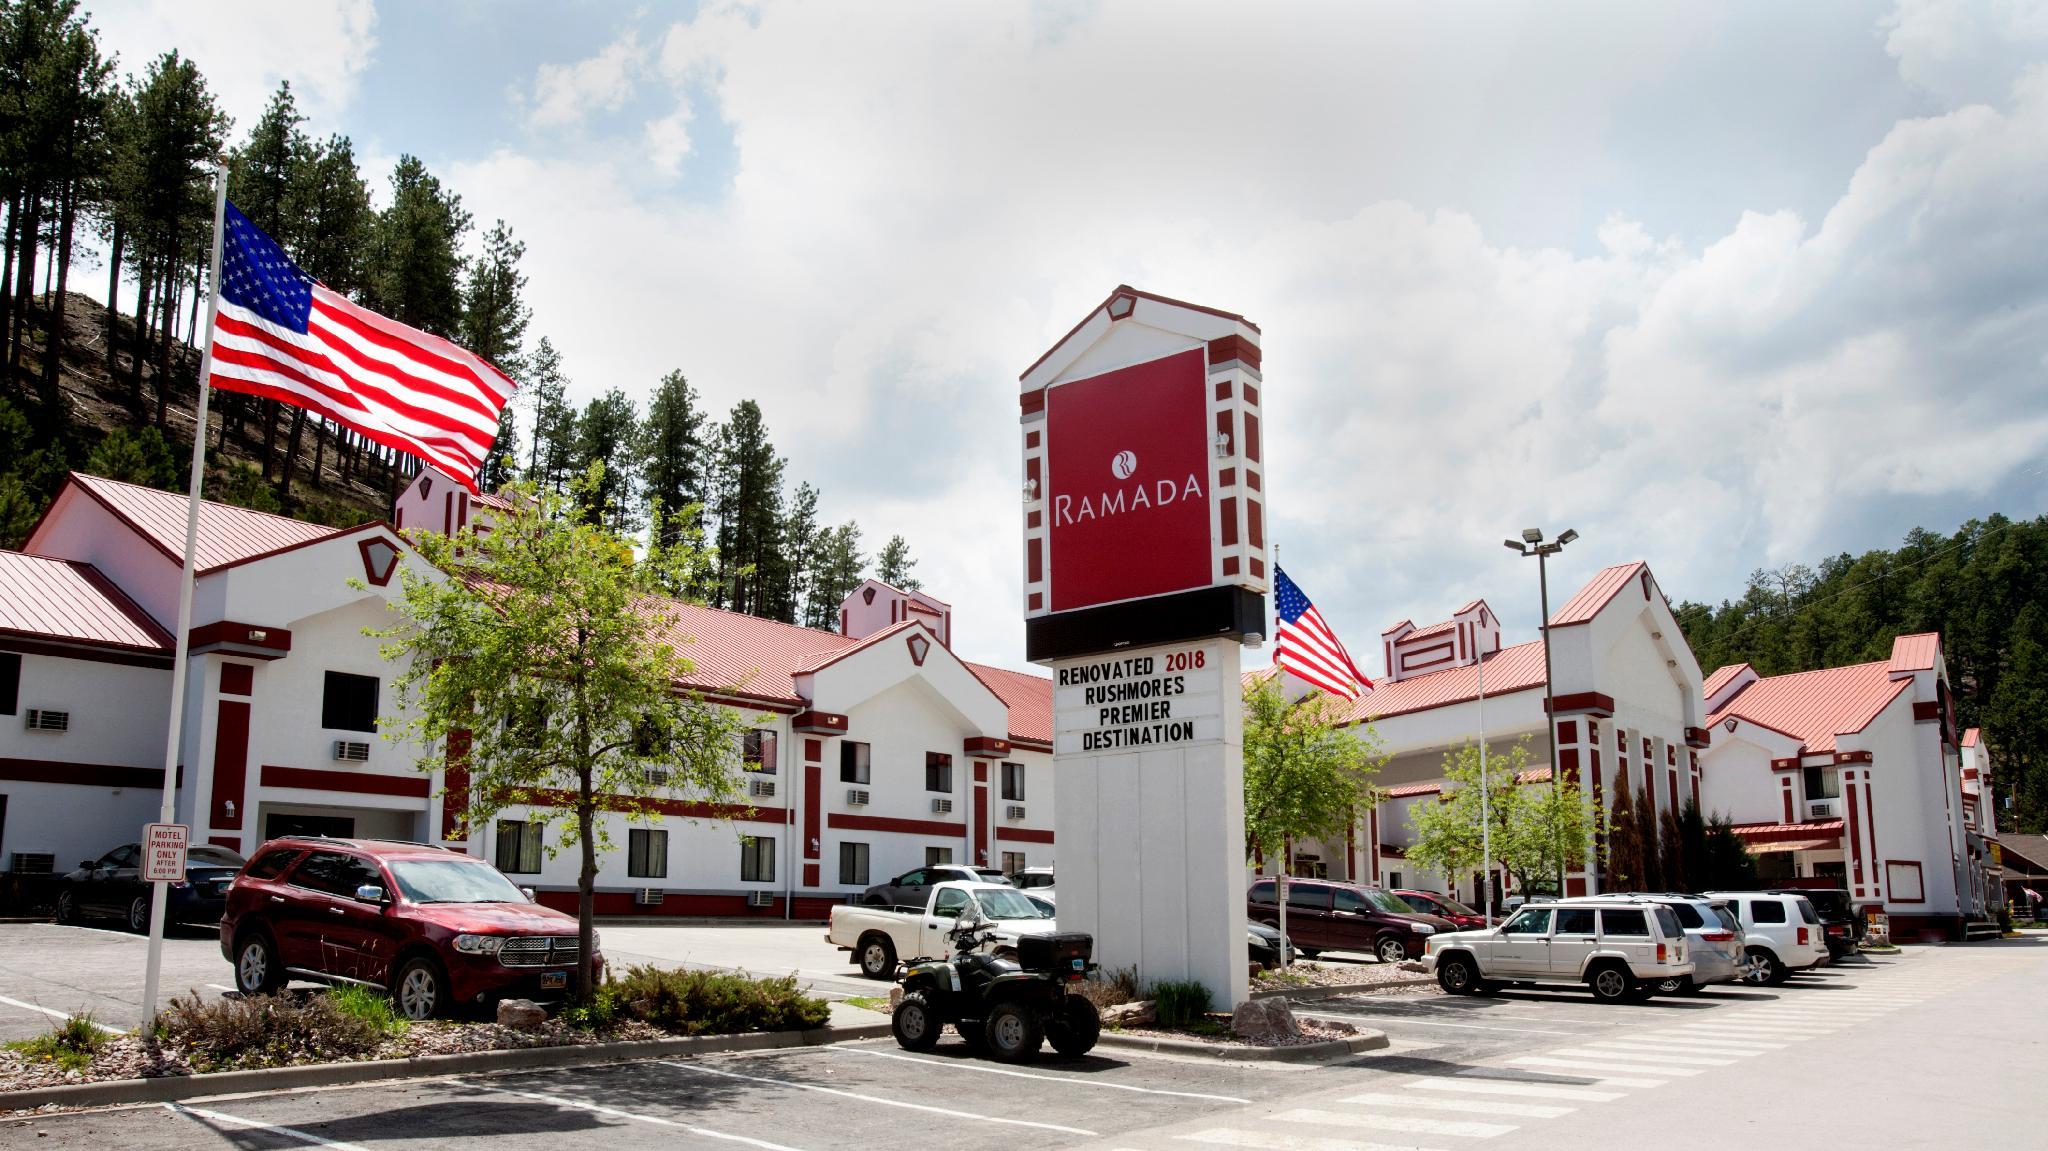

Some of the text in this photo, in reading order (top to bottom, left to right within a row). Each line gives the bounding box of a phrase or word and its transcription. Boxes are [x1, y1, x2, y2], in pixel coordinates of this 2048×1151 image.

[1055, 473, 1203, 527] RAMADA
[1059, 650, 1206, 686] RENOVATED 2018
[1085, 675, 1185, 705] RUSHMORES
[1100, 700, 1171, 726] PREMIER
[1083, 721, 1194, 751] DESTINATION
[151, 840, 184, 849] PARKING
[155, 831, 182, 840] MOTEL
[156, 850, 177, 859] ONLY
[156, 859, 176, 867] AFTER
